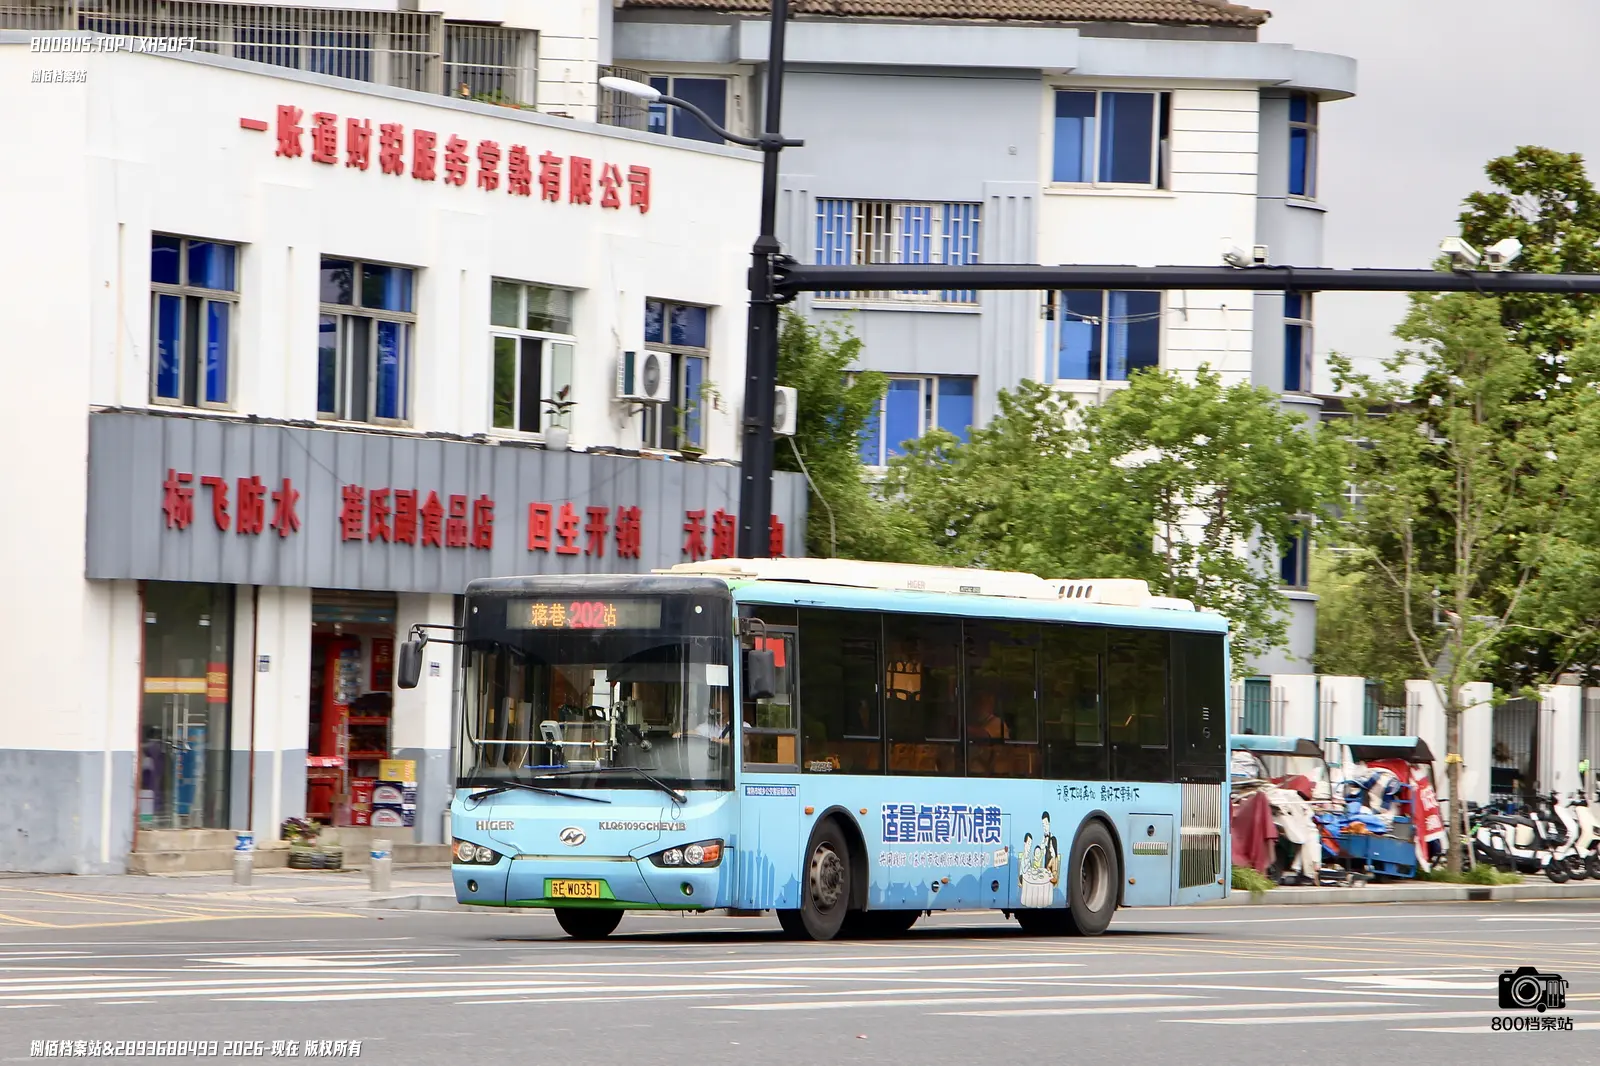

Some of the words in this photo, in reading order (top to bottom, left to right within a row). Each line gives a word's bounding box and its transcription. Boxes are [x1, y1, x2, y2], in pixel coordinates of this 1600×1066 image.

[239, 104, 652, 214] 一账通财税服务常熟有限公司
[339, 484, 494, 549] 崔氏副食品店
[476, 820, 515, 831] HIGER
[881, 804, 1002, 843] 适量点餐不浪费
